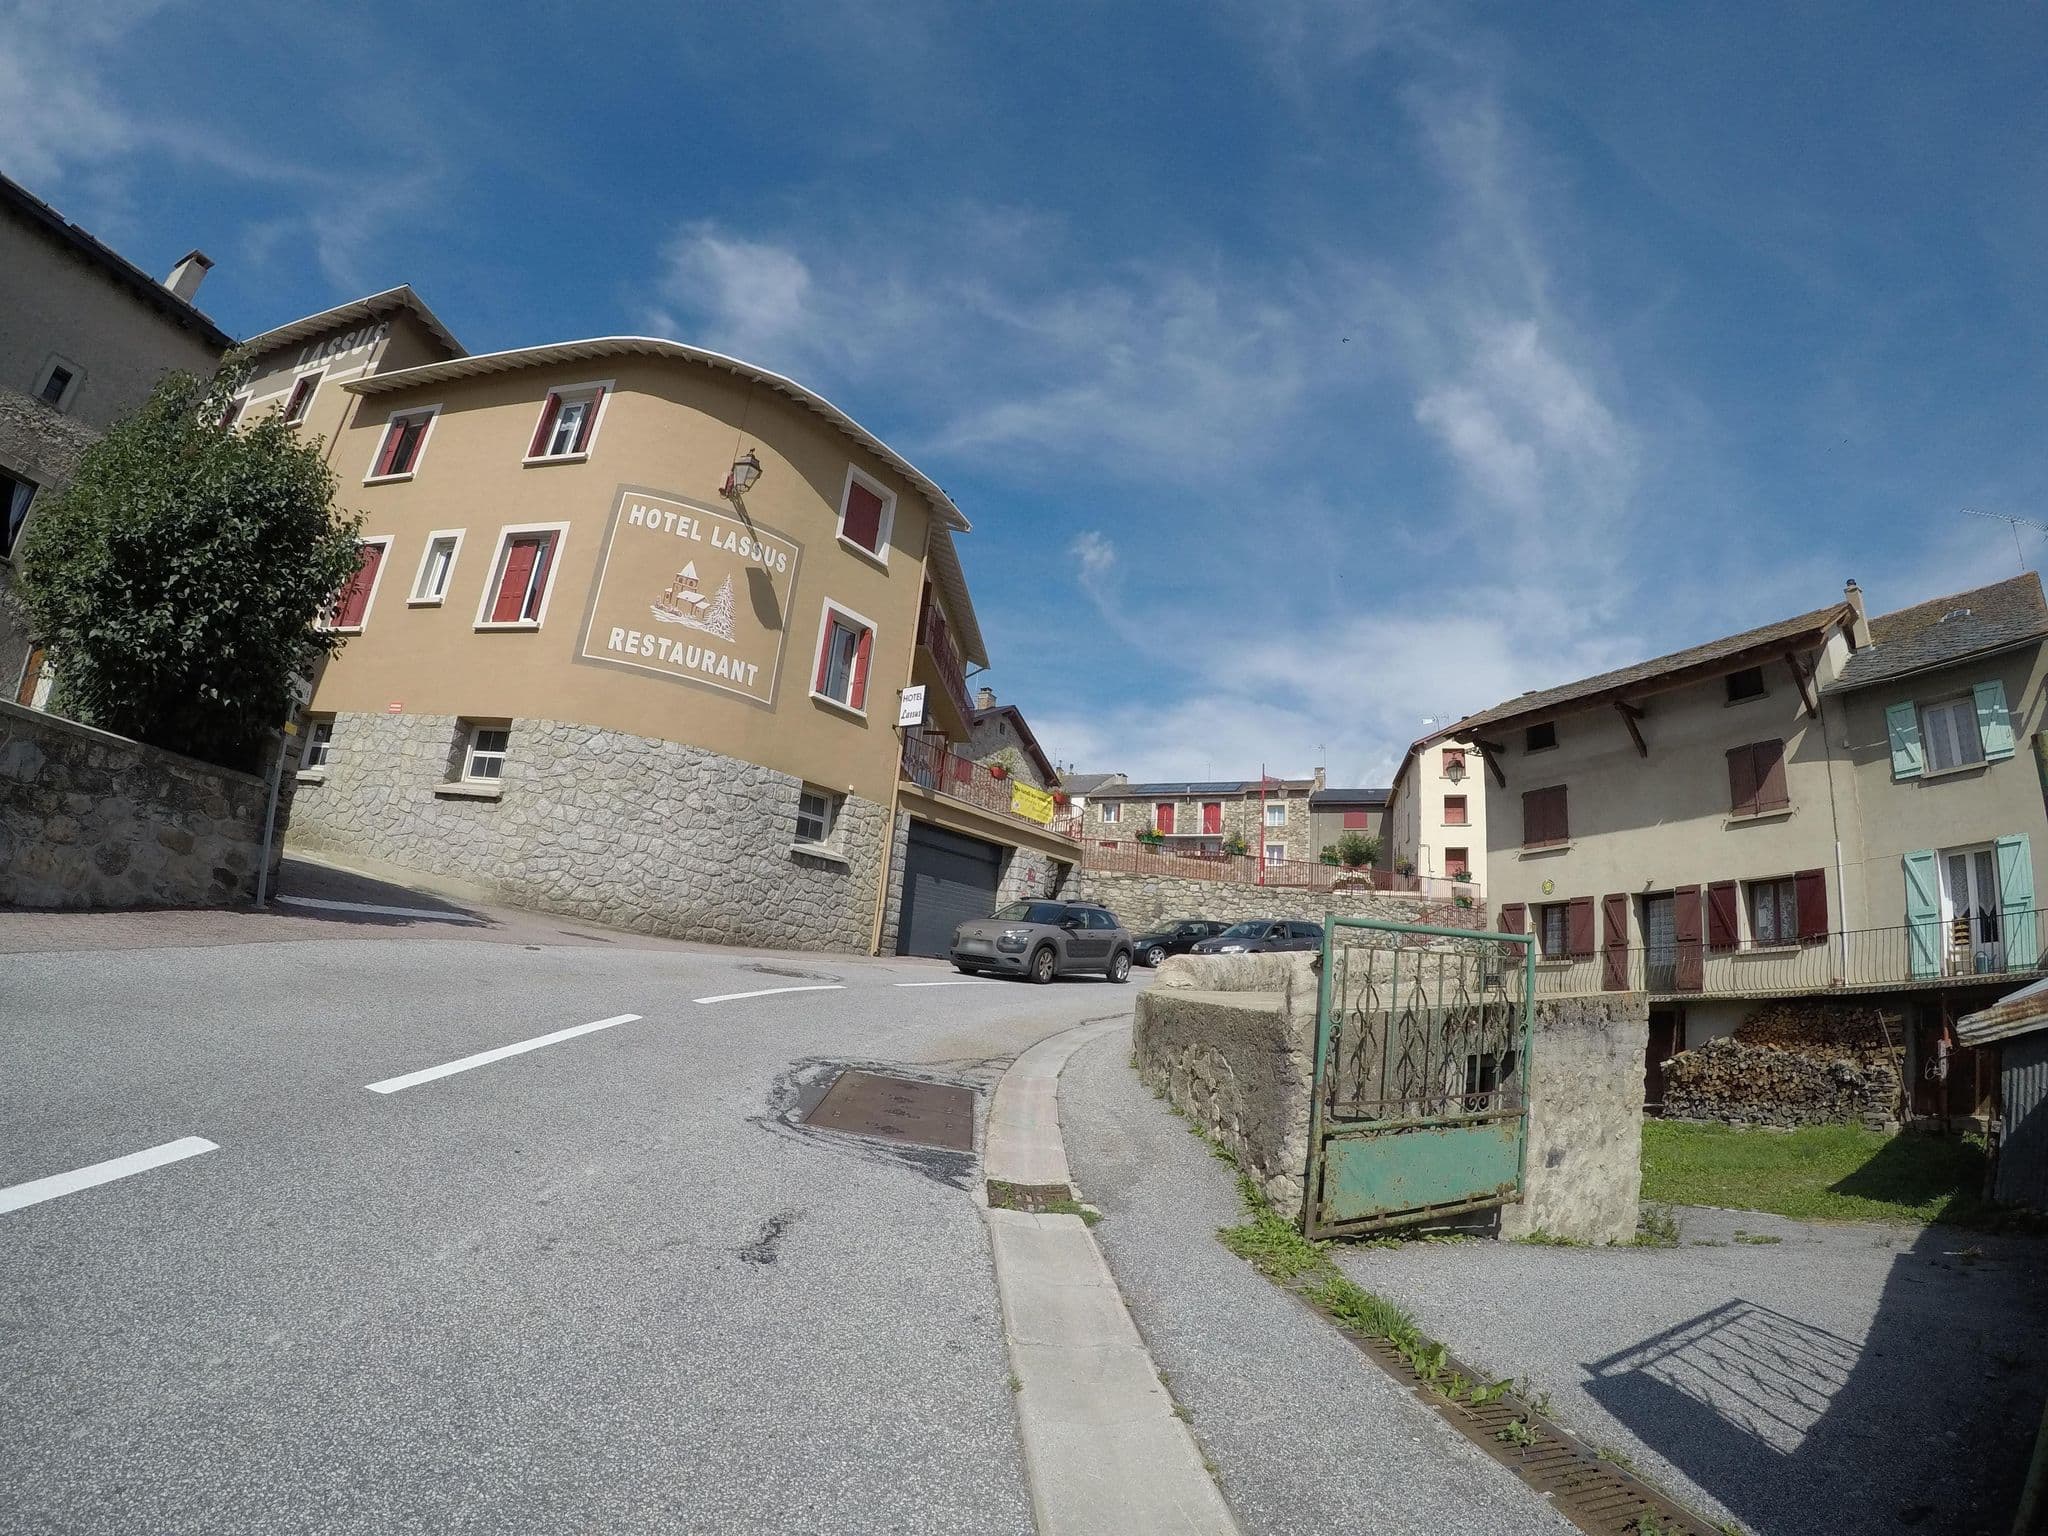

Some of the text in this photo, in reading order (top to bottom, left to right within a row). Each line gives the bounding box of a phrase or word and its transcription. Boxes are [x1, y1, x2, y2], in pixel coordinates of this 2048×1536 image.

[628, 504, 787, 573] HOTEL LASSUS
[608, 627, 759, 687] RESTAURANT
[901, 709, 922, 719] Lassus
[903, 693, 922, 703] HOTEL
